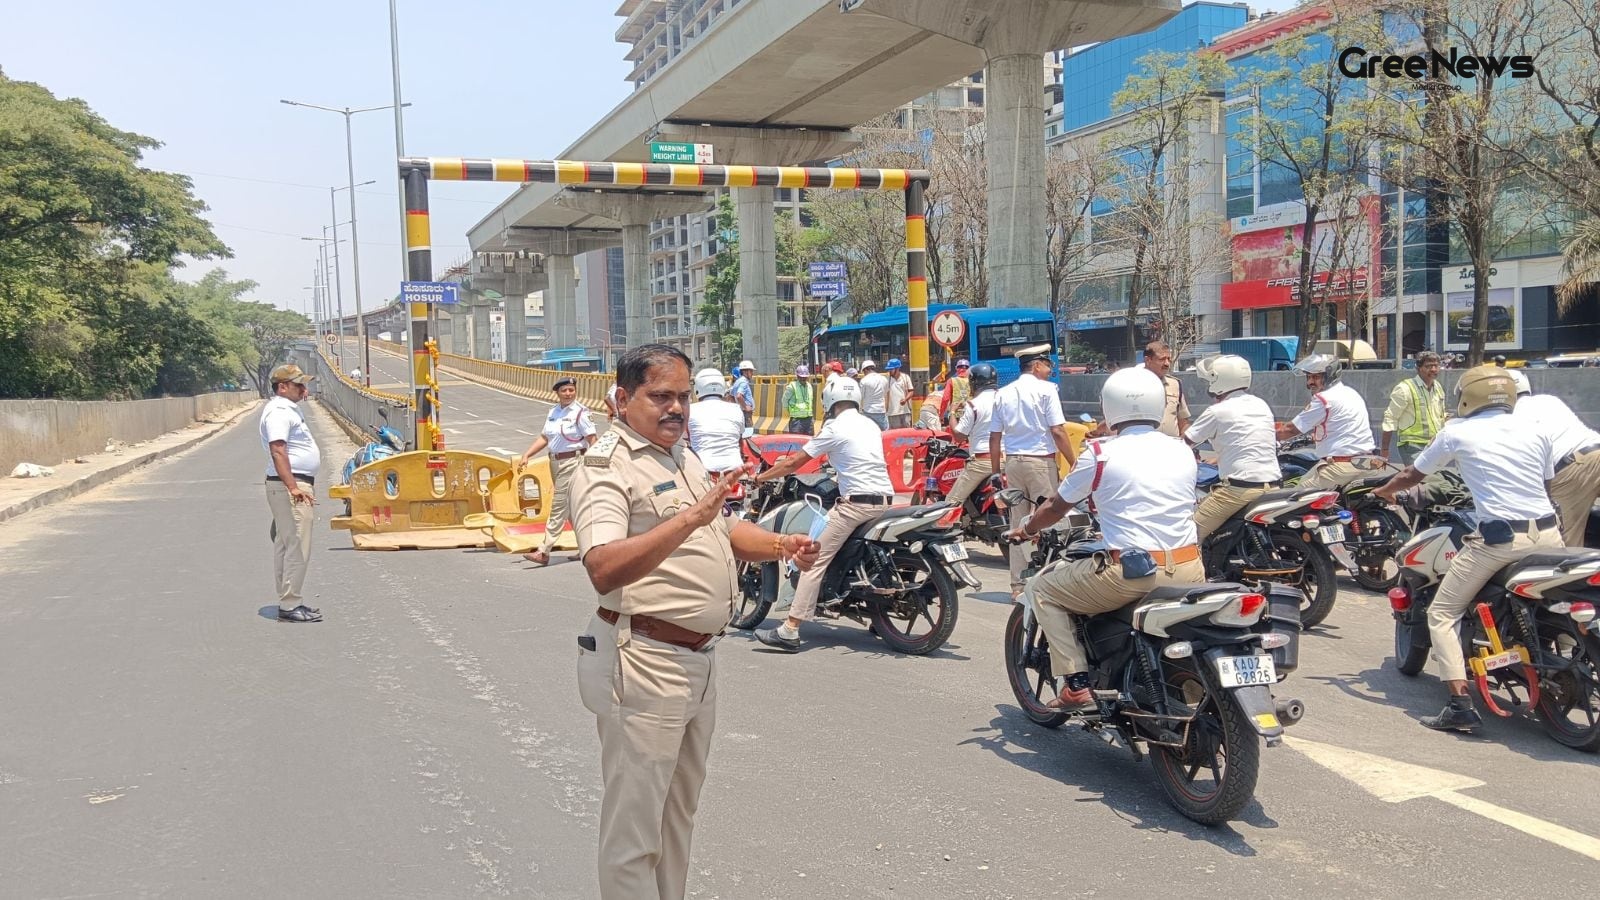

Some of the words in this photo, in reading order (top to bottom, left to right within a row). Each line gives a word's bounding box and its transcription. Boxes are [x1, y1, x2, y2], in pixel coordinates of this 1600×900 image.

[658, 144, 687, 152] WARNING
[653, 152, 675, 160] HEIGHT
[676, 153, 693, 161] LIMIT
[1267, 274, 1321, 288] FABRC
[405, 293, 443, 302] HOSUR
[937, 323, 960, 333] 4.5m
[943, 470, 961, 479] POLIC
[1233, 657, 1262, 671] KA02
[1235, 669, 1271, 685] G2825
